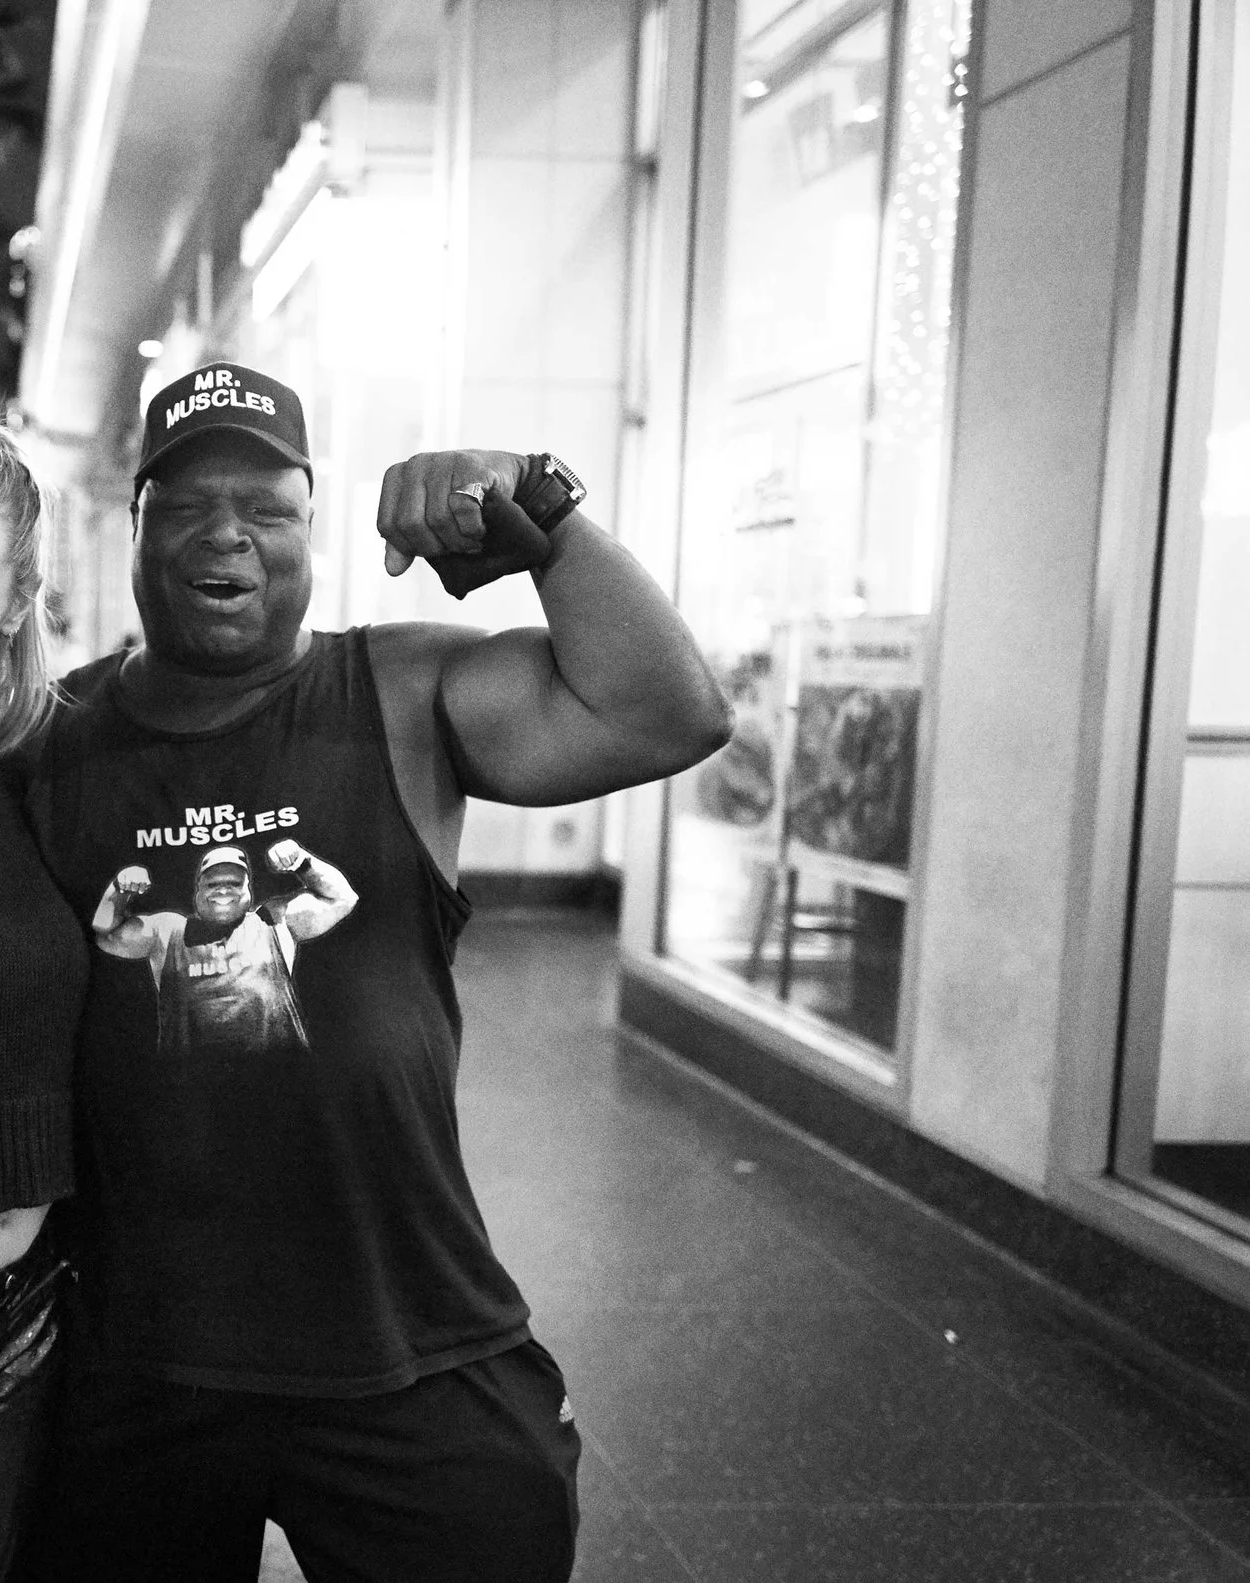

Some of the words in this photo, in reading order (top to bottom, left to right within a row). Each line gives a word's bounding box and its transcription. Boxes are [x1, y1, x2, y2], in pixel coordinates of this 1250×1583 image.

[195, 370, 240, 391] MR.
[166, 389, 276, 429] MUSCLES
[137, 807, 300, 848] MUSCLES
[185, 804, 246, 827] MR.
